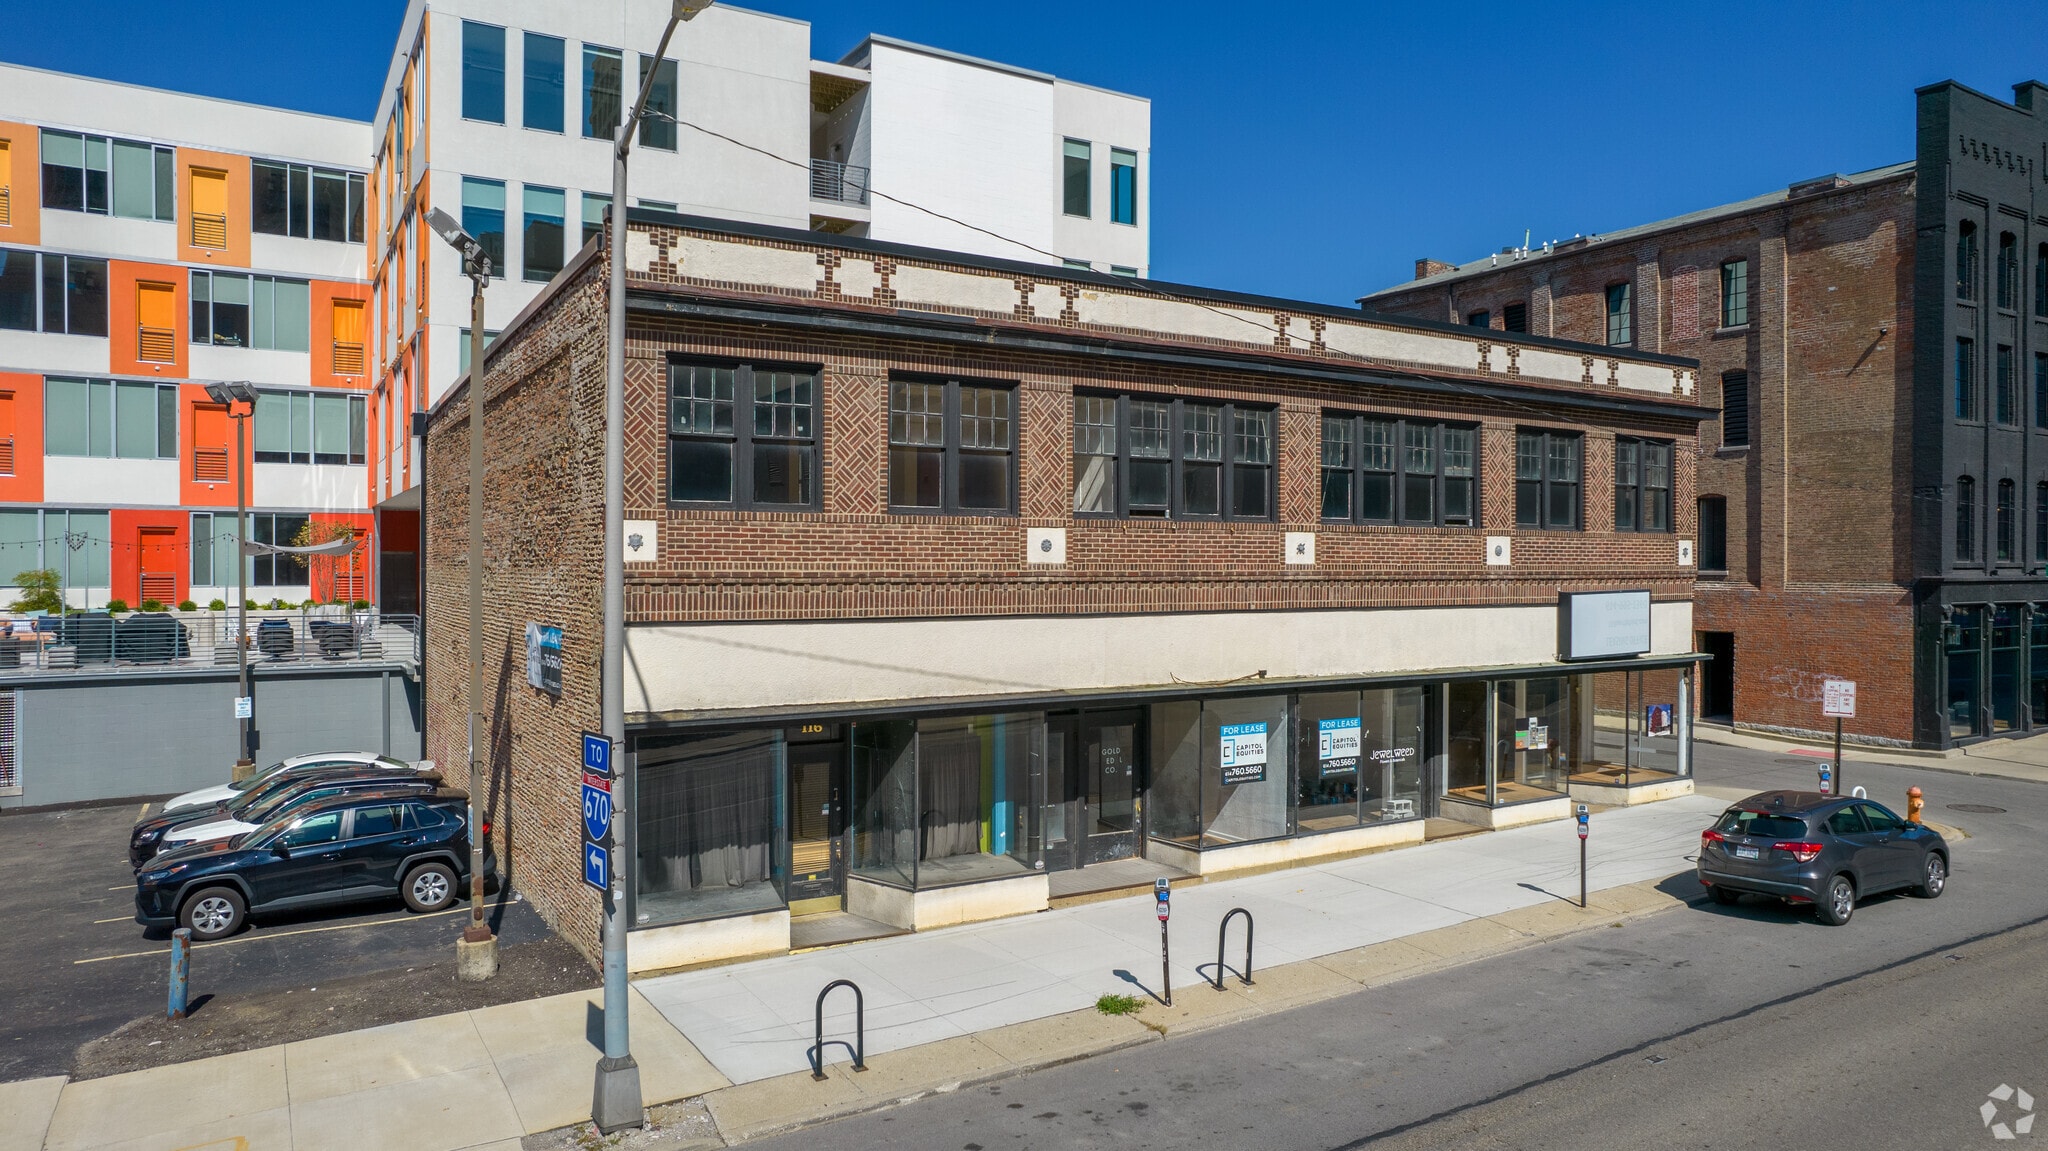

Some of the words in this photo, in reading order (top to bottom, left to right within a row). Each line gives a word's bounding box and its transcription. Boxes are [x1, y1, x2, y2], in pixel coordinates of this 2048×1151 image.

[1321, 721, 1336, 729] FOR
[1337, 719, 1359, 728] LEASE
[801, 725, 823, 733] 116
[1223, 727, 1239, 735] FOR
[1240, 724, 1264, 734] LEASE
[1332, 736, 1357, 744] CAPITOL
[1236, 743, 1262, 751] CAPITOL
[1332, 742, 1358, 750] EQUITIES
[590, 744, 603, 763] TO
[1101, 747, 1121, 756] GOLD
[1236, 749, 1264, 757] EQUITIES
[1105, 766, 1118, 774] CO.
[587, 776, 607, 790] INTERSTATE
[585, 790, 608, 825] 670
